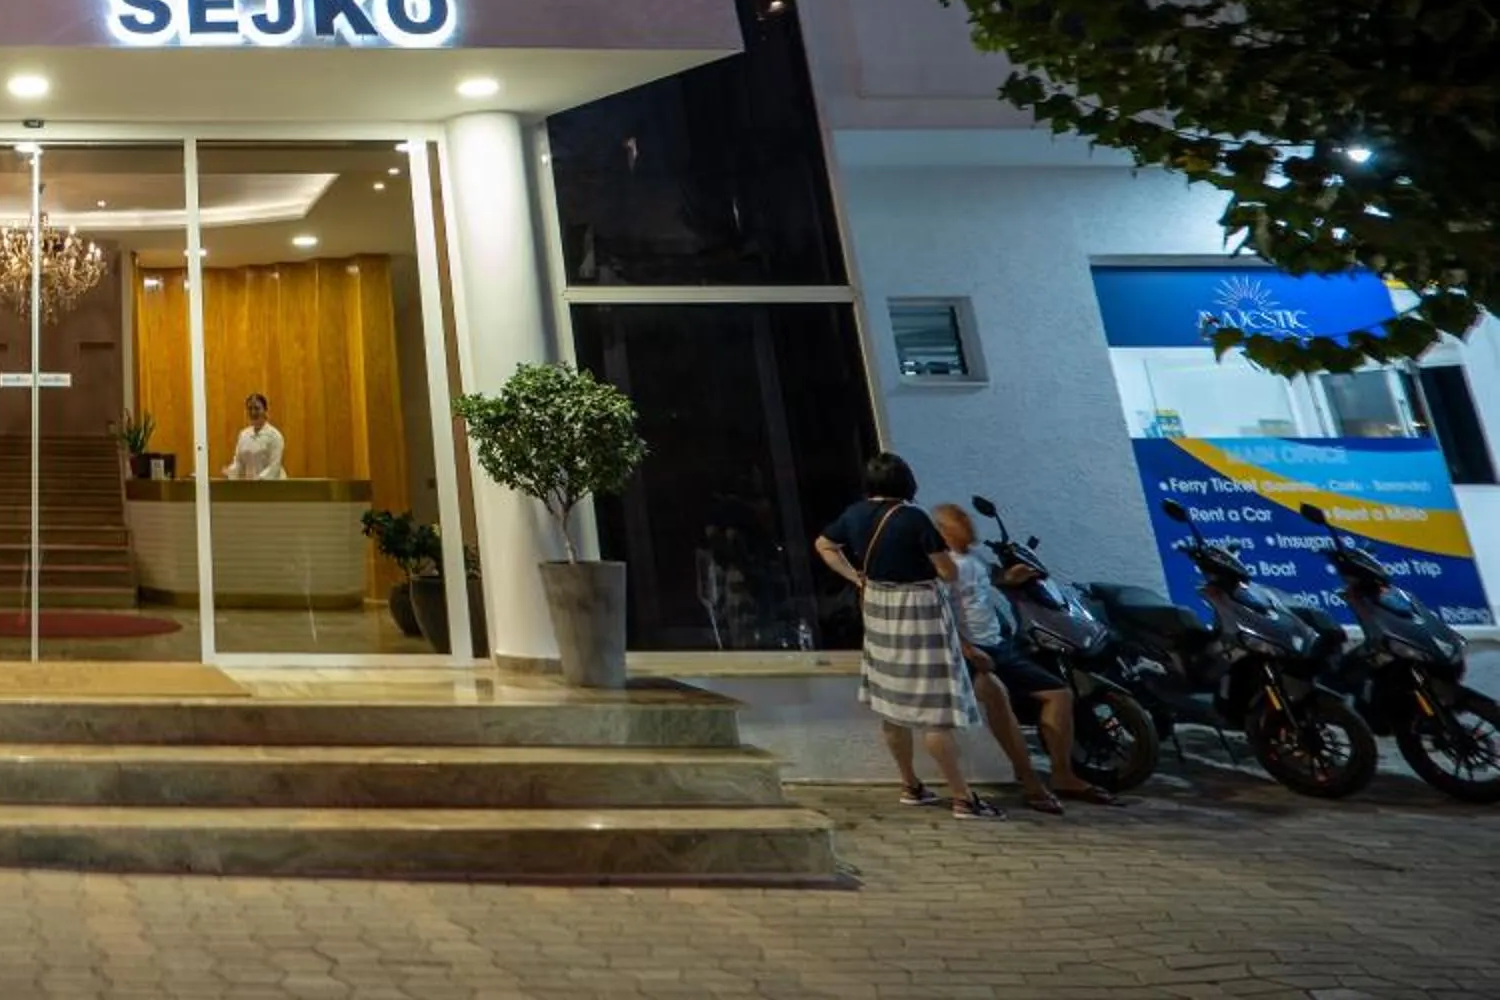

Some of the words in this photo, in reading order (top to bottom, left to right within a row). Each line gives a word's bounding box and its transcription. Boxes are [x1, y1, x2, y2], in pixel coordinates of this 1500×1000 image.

[1281, 445, 1348, 465] OFFICE
[1169, 478, 1208, 495] Ferry
[1209, 477, 1258, 493] Ticket
[1189, 507, 1226, 521] Rent
[1228, 510, 1241, 522] a
[1242, 507, 1272, 522] Car
[1276, 532, 1356, 549] Insurane
[1258, 561, 1297, 576] Boat
[1384, 560, 1411, 576] oat
[1411, 559, 1442, 578] Trip
